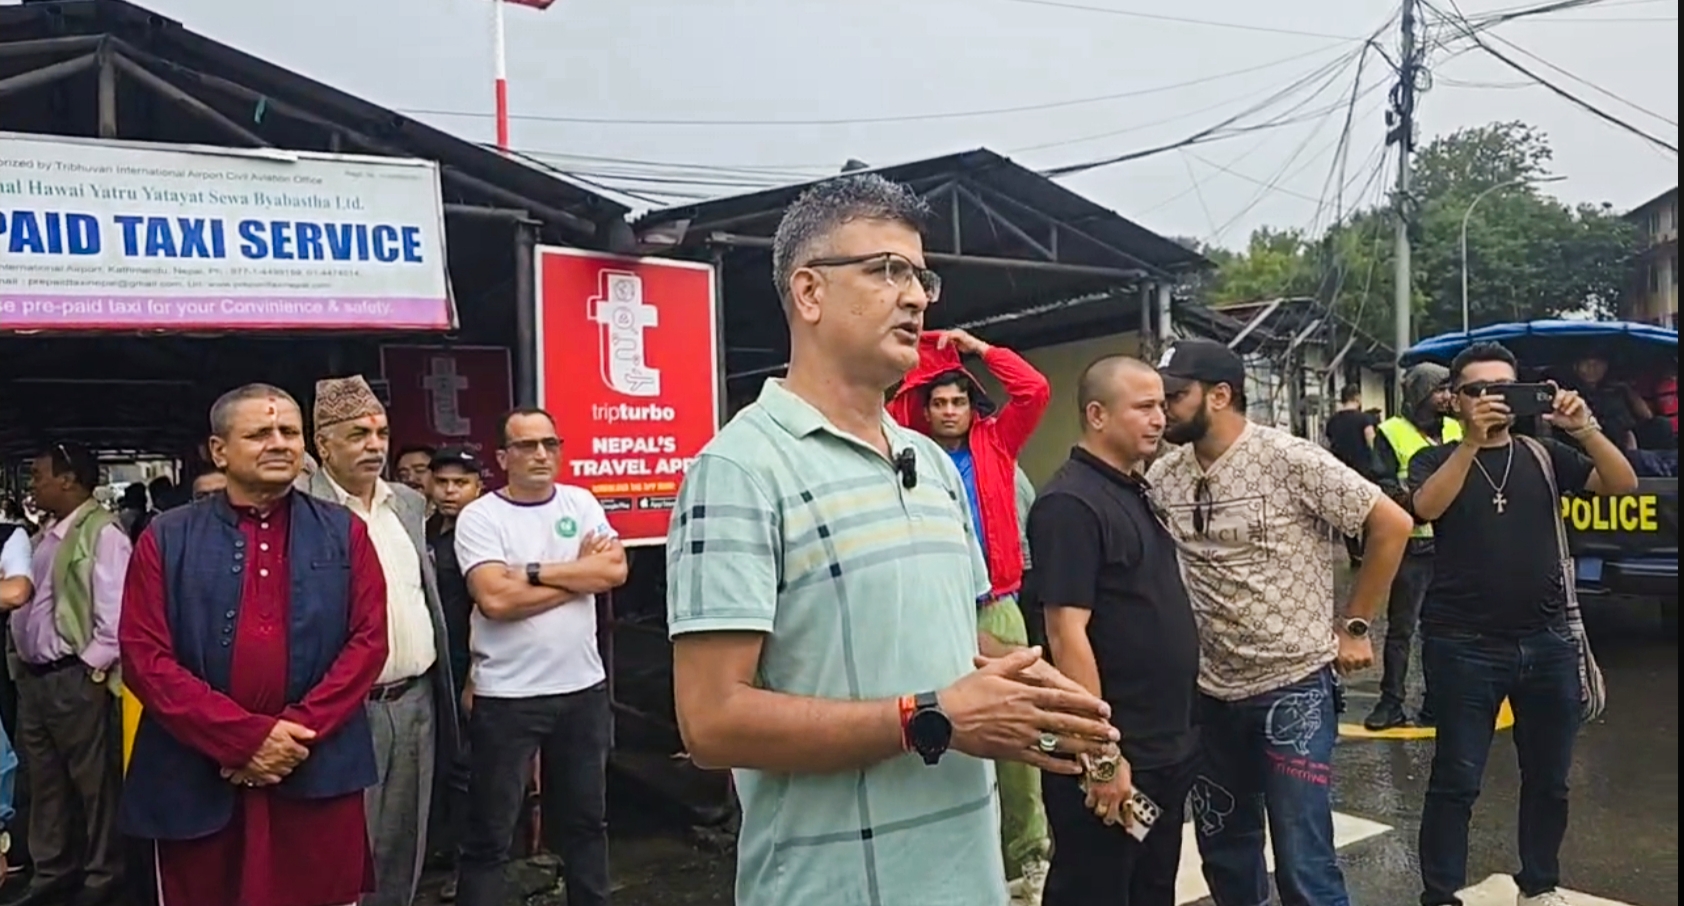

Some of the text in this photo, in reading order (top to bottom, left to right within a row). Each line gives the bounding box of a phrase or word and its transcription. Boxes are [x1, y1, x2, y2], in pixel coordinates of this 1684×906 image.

[37, 160, 52, 171] by
[56, 161, 113, 173] Tribhuvan
[117, 165, 186, 178] International
[188, 170, 224, 180] Airport
[251, 172, 291, 183] Aviation
[293, 174, 323, 185] Office
[28, 180, 85, 198] Hawai
[90, 183, 137, 201] Yatru
[142, 187, 204, 206] Yatayat
[208, 190, 249, 206] Sewa
[253, 192, 331, 210] Byabastha
[336, 196, 365, 211] Ltd.
[0, 210, 424, 264] AID TAXI SERVICE
[22, 298, 103, 317] pre-paid
[109, 299, 142, 314] taxi
[148, 299, 173, 314] for
[176, 301, 215, 318] your
[221, 299, 323, 315] Convinience
[327, 300, 339, 314] &
[592, 403, 676, 425] tripturbo
[591, 436, 677, 454] NEPAL'S
[569, 459, 652, 477] TRAVEL
